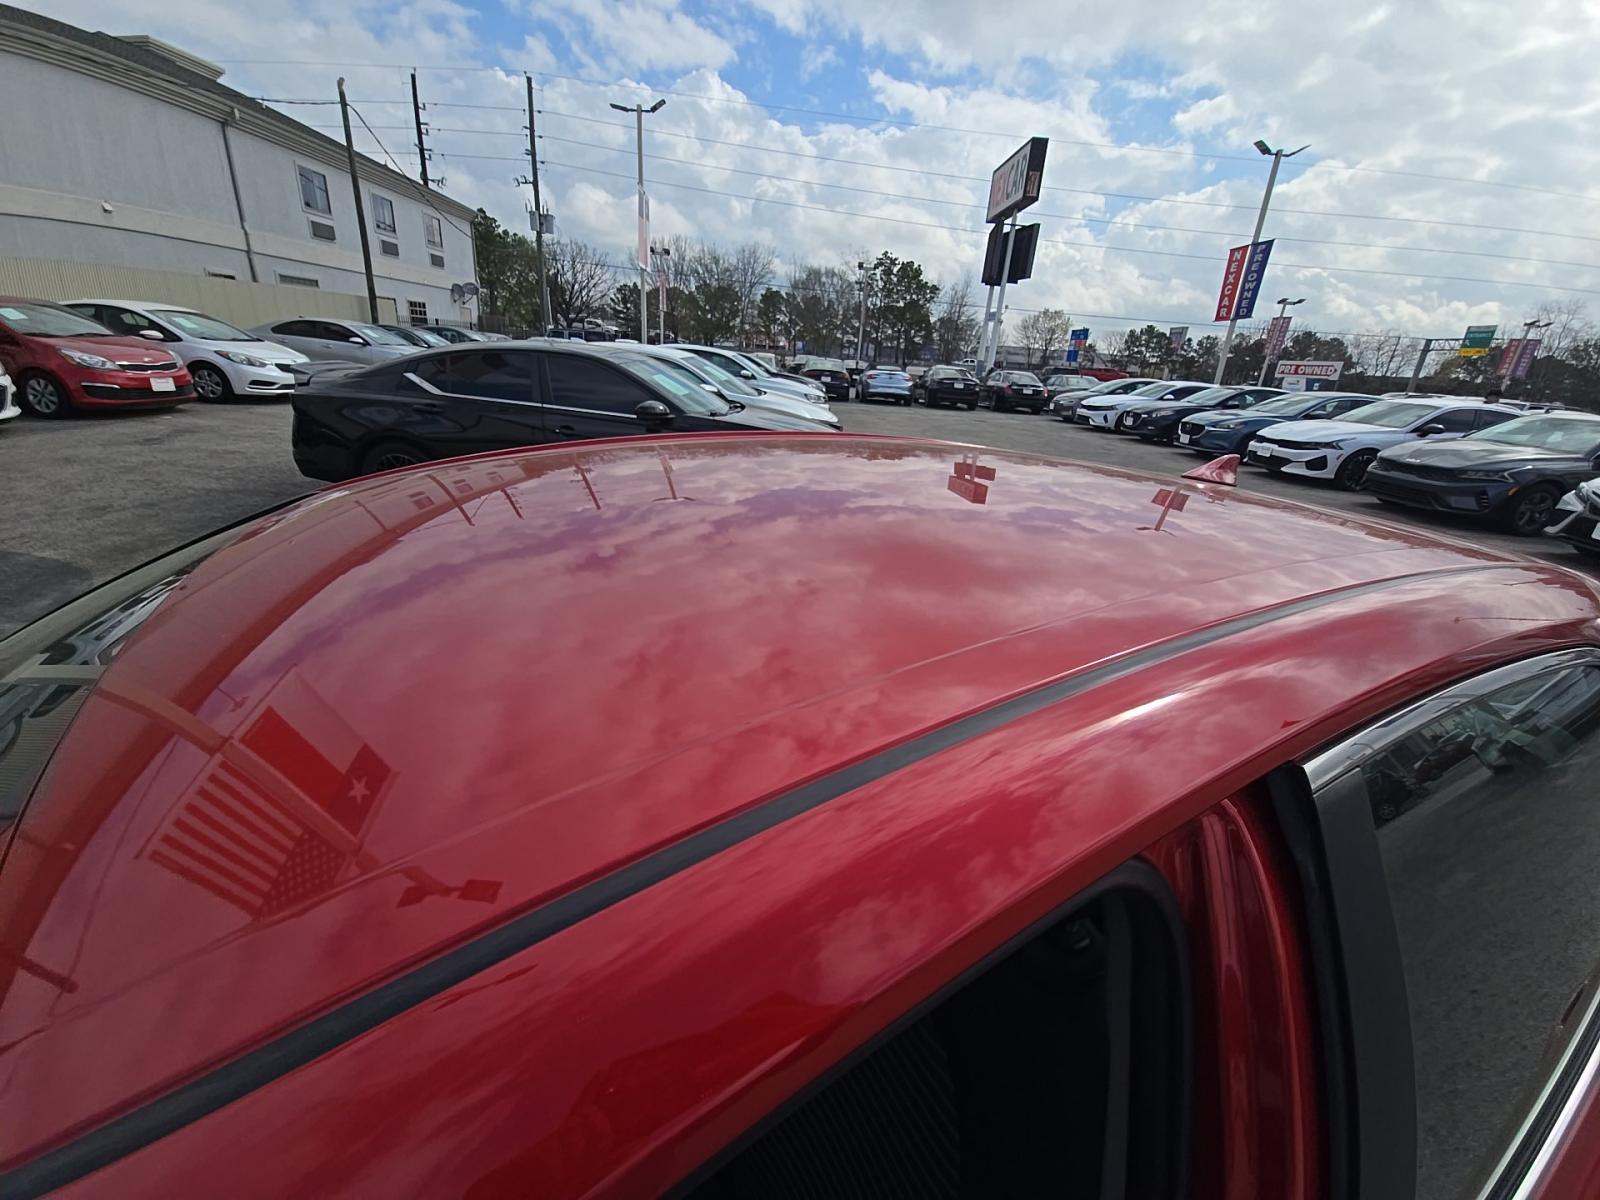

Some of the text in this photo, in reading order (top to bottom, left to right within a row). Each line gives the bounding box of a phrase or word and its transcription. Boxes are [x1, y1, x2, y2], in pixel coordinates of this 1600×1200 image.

[1219, 249, 1243, 318] NEXCAR
[1278, 365, 1335, 375] PRE OWNED
